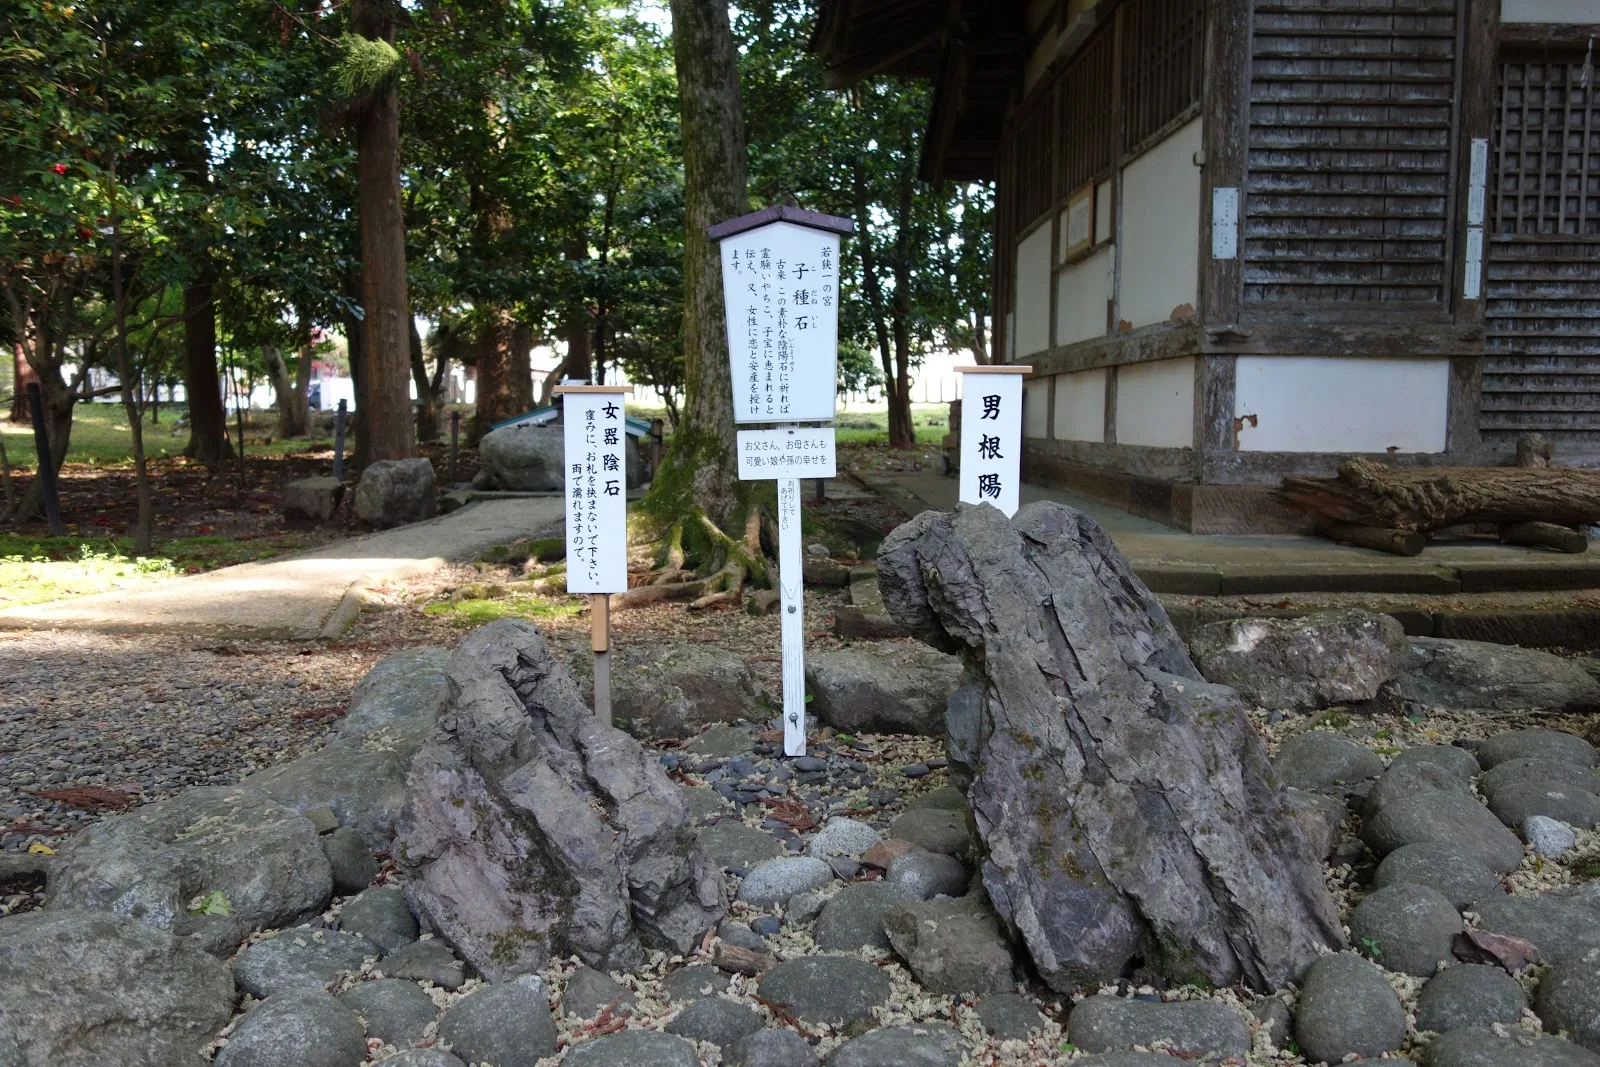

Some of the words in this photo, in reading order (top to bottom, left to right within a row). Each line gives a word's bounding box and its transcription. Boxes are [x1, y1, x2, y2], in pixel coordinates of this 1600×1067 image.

[731, 249, 743, 275] ます。
[792, 262, 810, 331] 子種石
[820, 246, 833, 307] 若狭一の宮
[601, 401, 621, 497] 女器陰石
[746, 454, 827, 467] 可愛い娘や孫の幸せを
[977, 394, 1004, 500] 男根陽
[572, 463, 585, 563] 雨で濡れますので。
